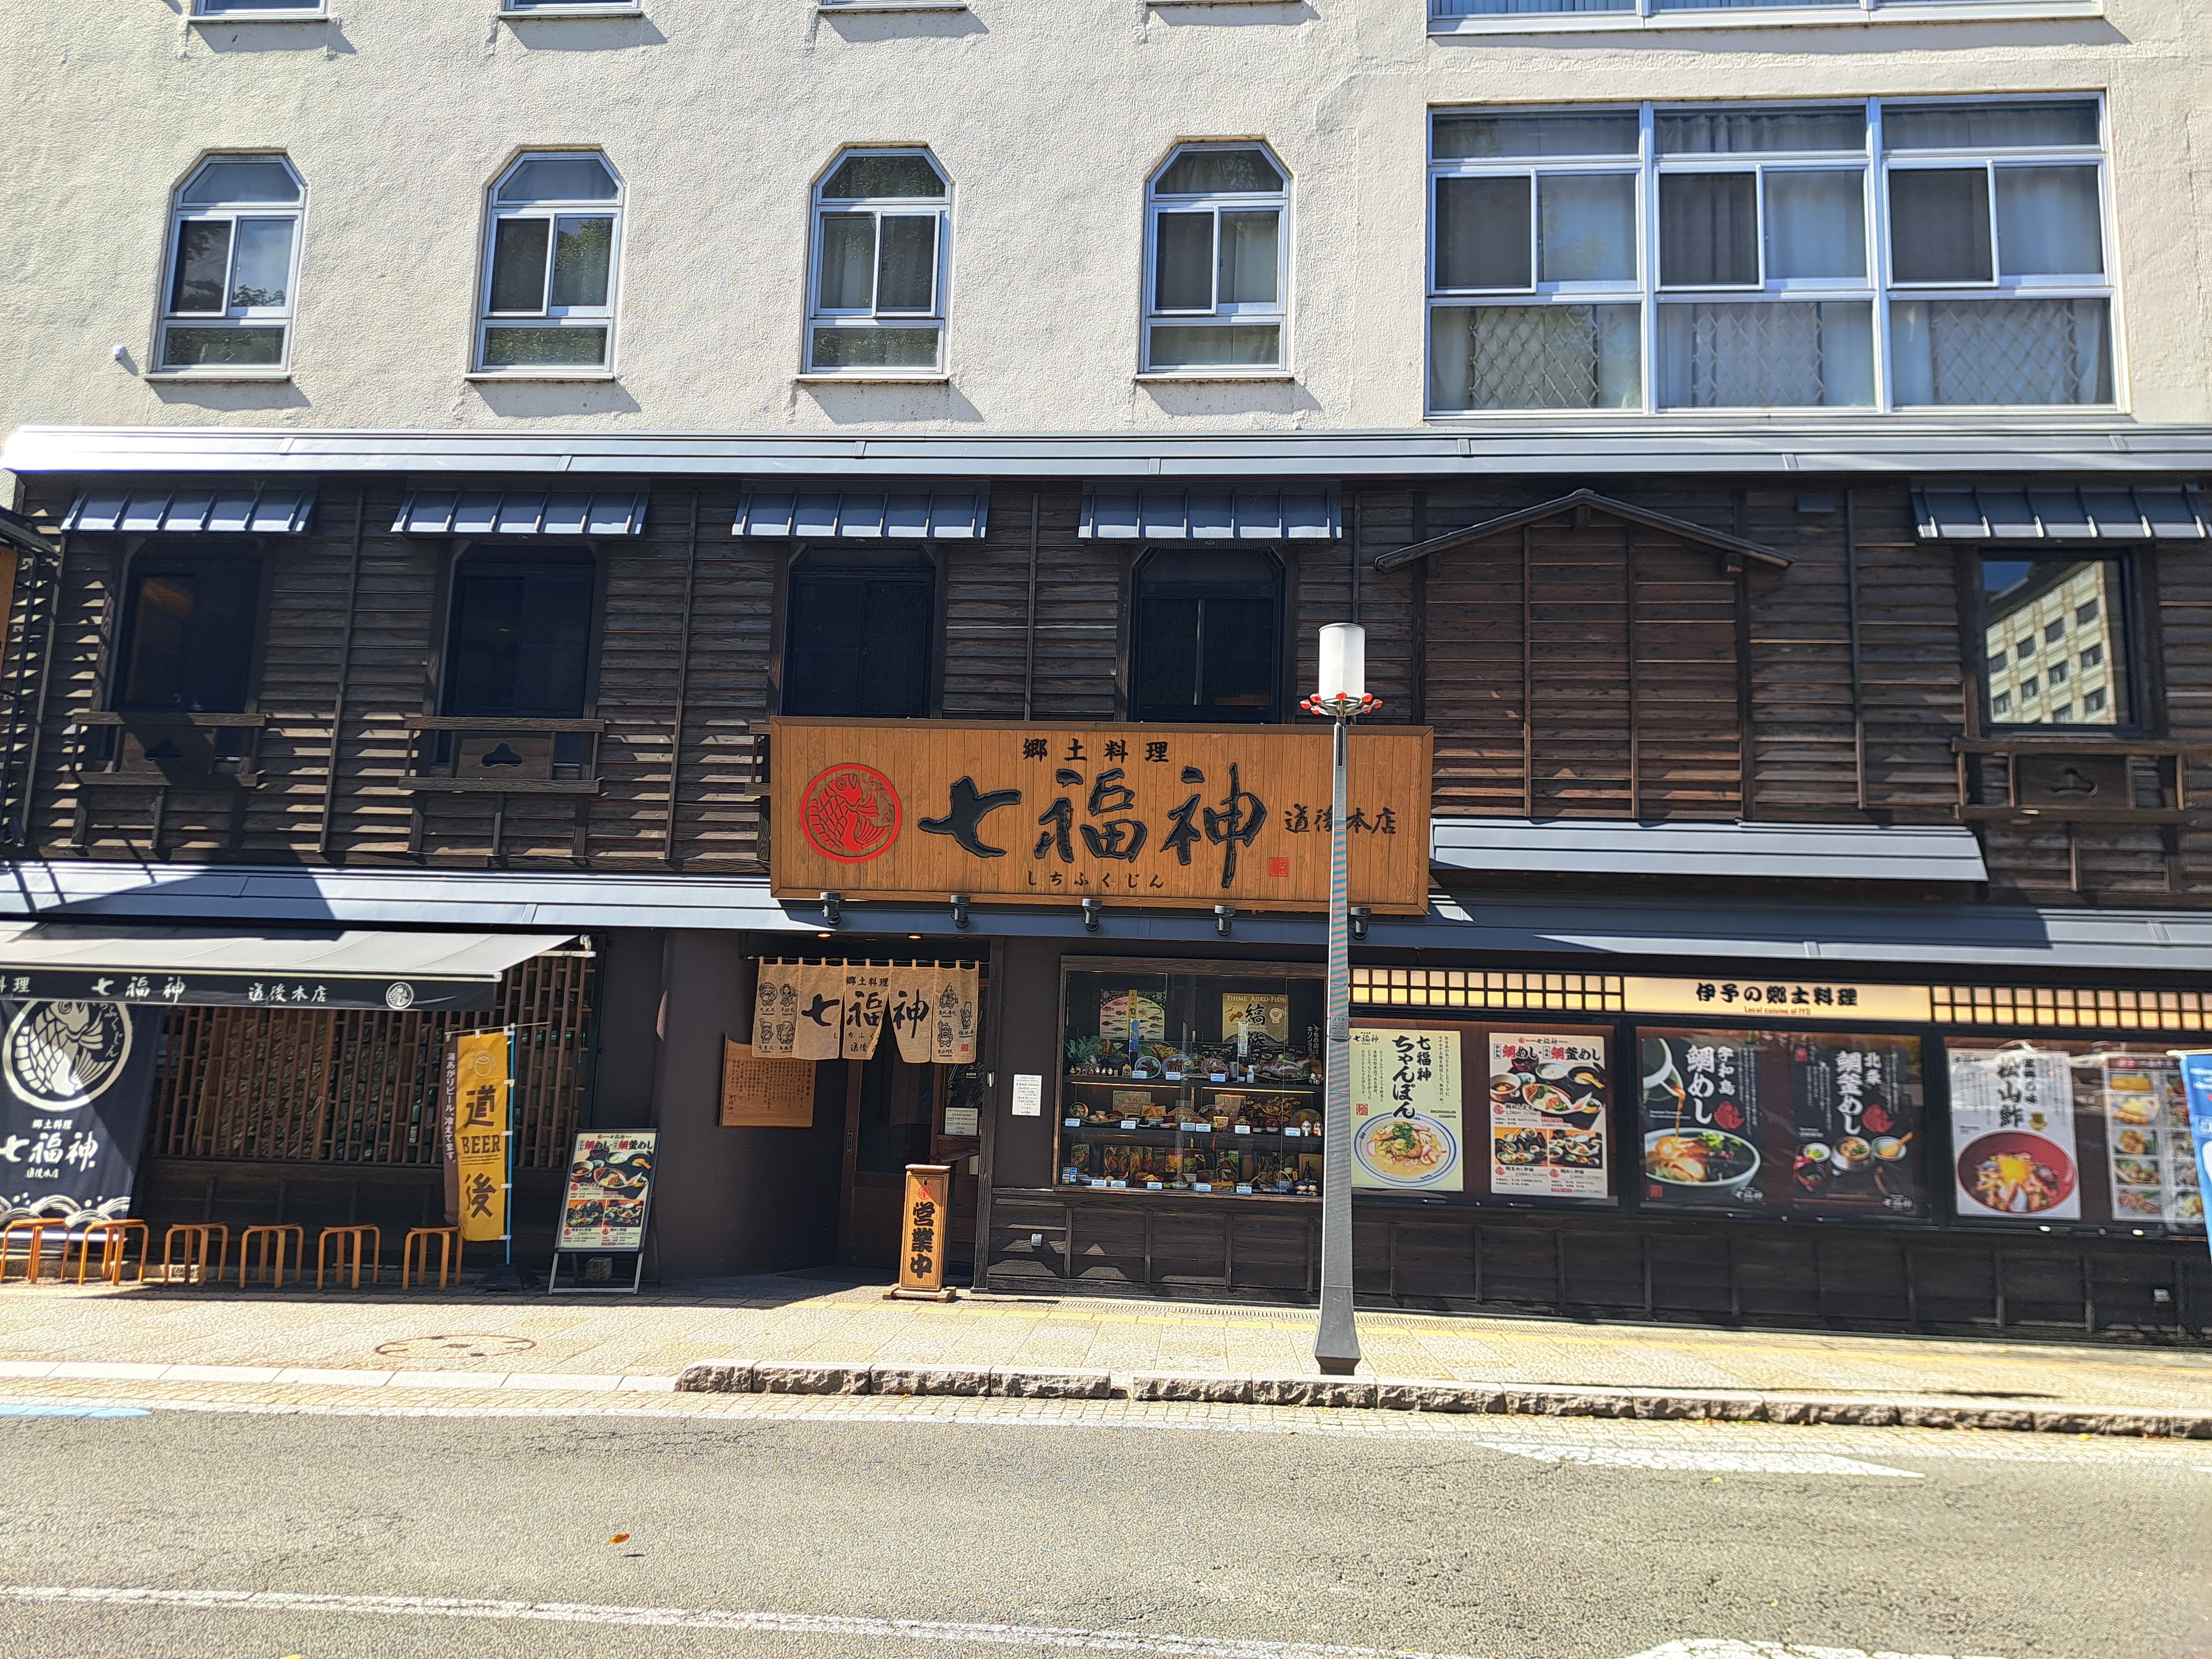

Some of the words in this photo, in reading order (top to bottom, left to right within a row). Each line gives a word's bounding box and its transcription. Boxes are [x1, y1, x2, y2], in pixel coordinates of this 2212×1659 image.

[1023, 738, 1169, 763] 郷土料理
[918, 763, 1266, 888] 七福神
[1028, 870, 1164, 889] しちふくじん
[91, 976, 186, 1000] 七福神
[248, 982, 329, 1004] 道後本店
[846, 976, 889, 987] 郷土料理
[1696, 983, 1858, 1006] 伊予の郷土料理
[802, 989, 929, 1039] 七福神
[1416, 1036, 1432, 1082] 七福神
[1551, 1046, 1601, 1061] 鯛釜めし
[1717, 1046, 1736, 1096] 宇和島
[1392, 1035, 1416, 1119] ちゃんぽん
[1685, 1044, 1715, 1125] 鯛めし
[1835, 1050, 1864, 1135] 鯛釜めし
[465, 1084, 497, 1127] 道
[0, 1130, 98, 1172] 七福神
[461, 1134, 500, 1154] BEER
[465, 1173, 497, 1219] 後
[910, 1202, 935, 1279] 営業中
